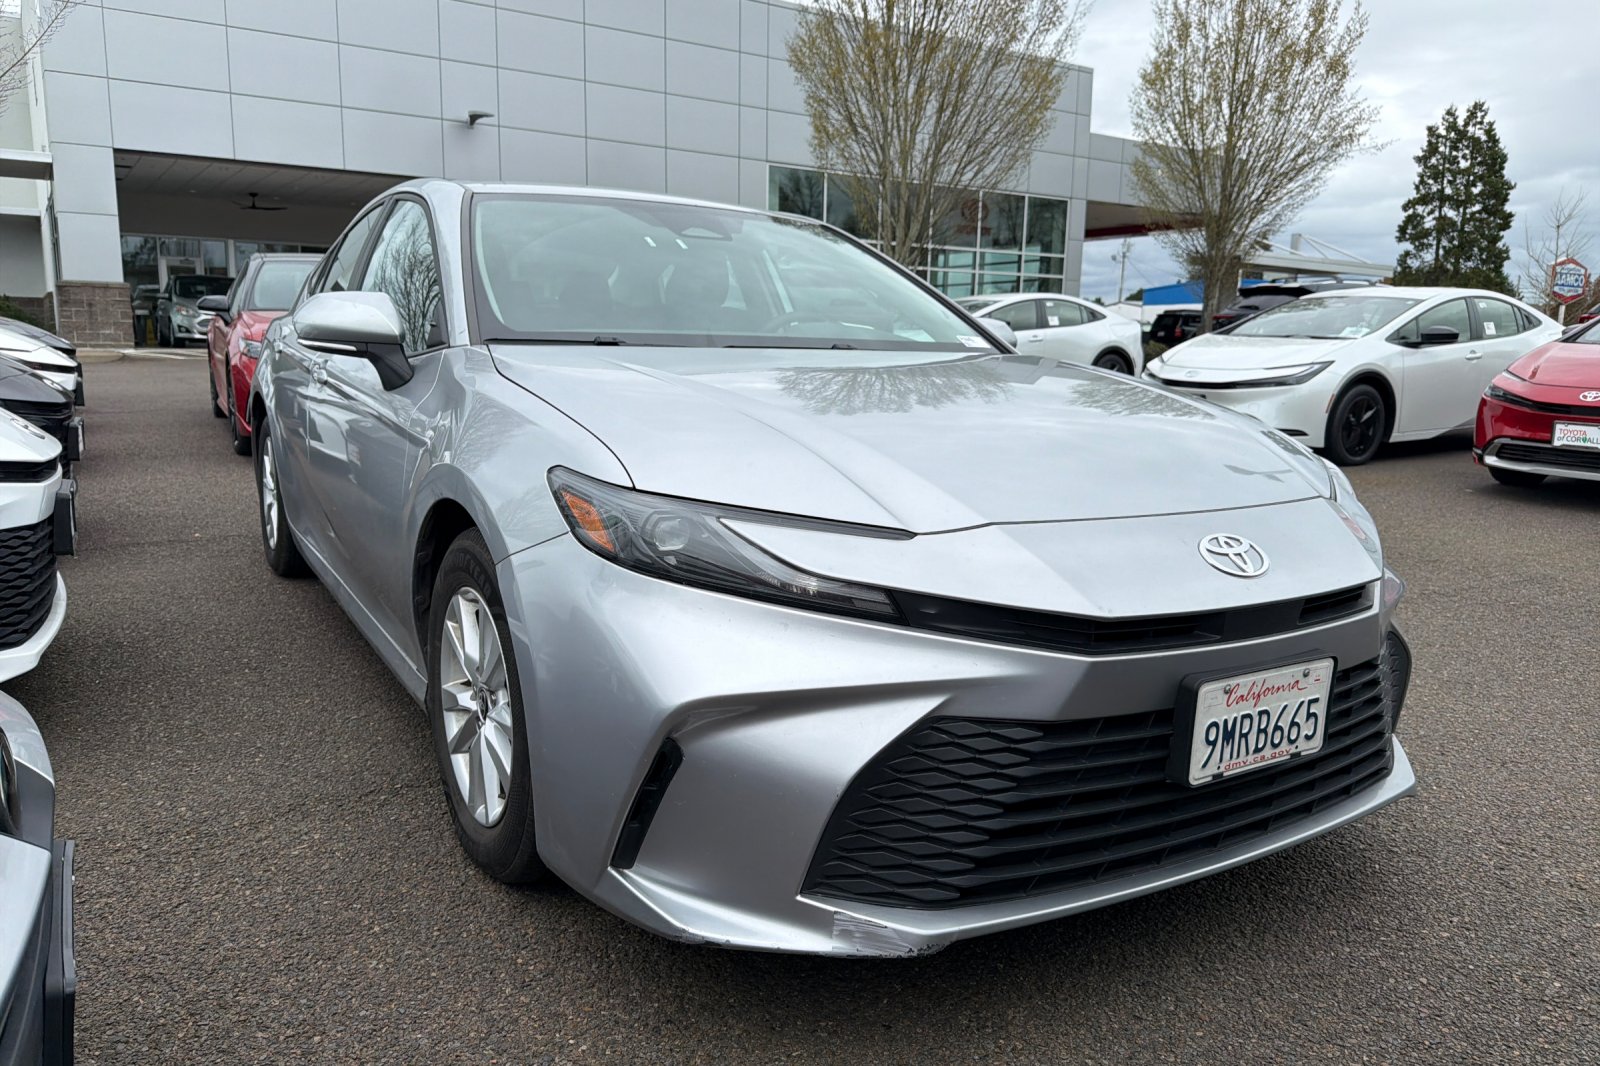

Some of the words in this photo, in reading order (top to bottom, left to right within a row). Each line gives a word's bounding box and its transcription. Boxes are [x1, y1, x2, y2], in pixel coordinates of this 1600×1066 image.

[1555, 273, 1585, 287] AAMCO
[1557, 434, 1566, 442] of
[1559, 428, 1587, 436] TOYOTA
[1226, 679, 1308, 708] California
[1201, 697, 1320, 769] 9MRB665
[1224, 748, 1291, 771] dmv.ca.gov
